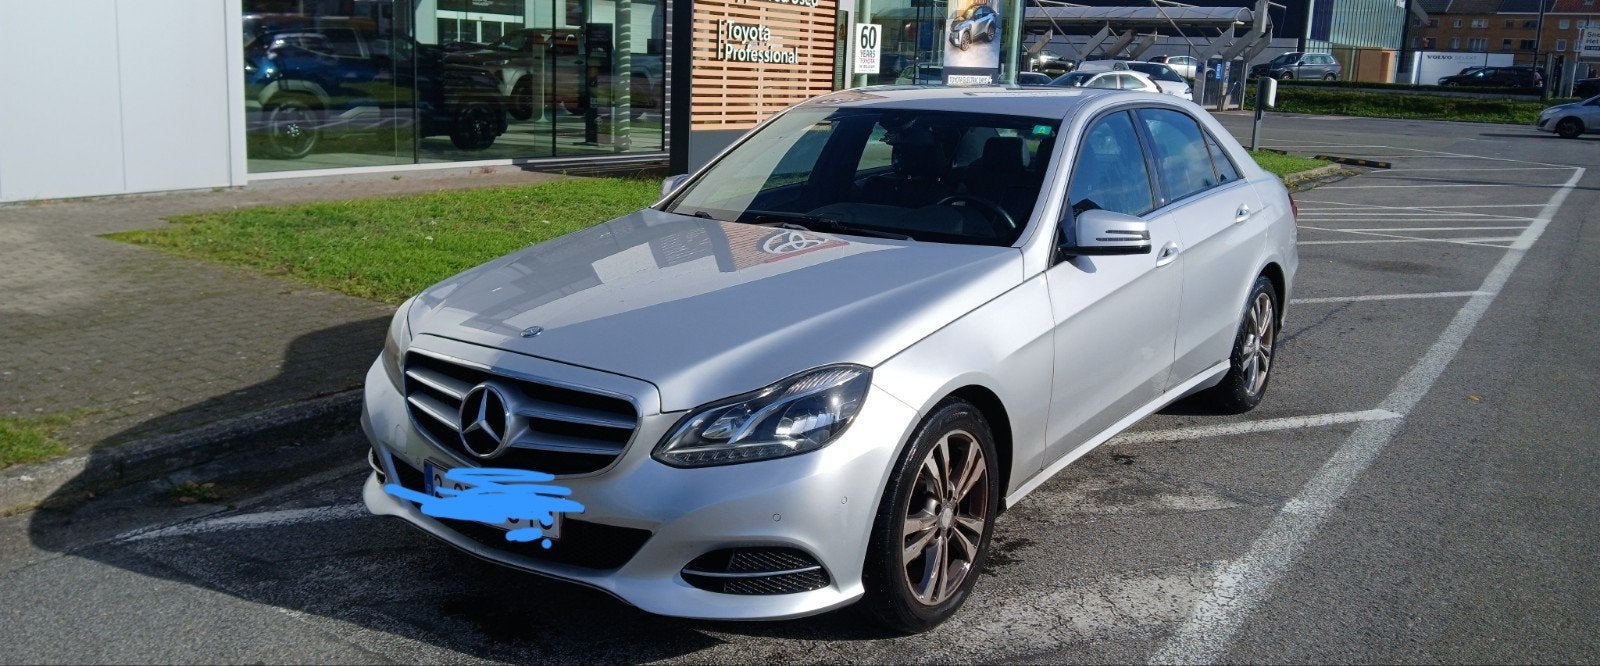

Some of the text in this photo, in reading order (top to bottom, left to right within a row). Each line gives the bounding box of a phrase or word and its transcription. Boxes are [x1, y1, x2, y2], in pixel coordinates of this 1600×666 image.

[726, 19, 771, 44] Toyota
[860, 25, 877, 49] 60
[725, 43, 798, 63] Professional
[860, 50, 876, 58] YEARS
